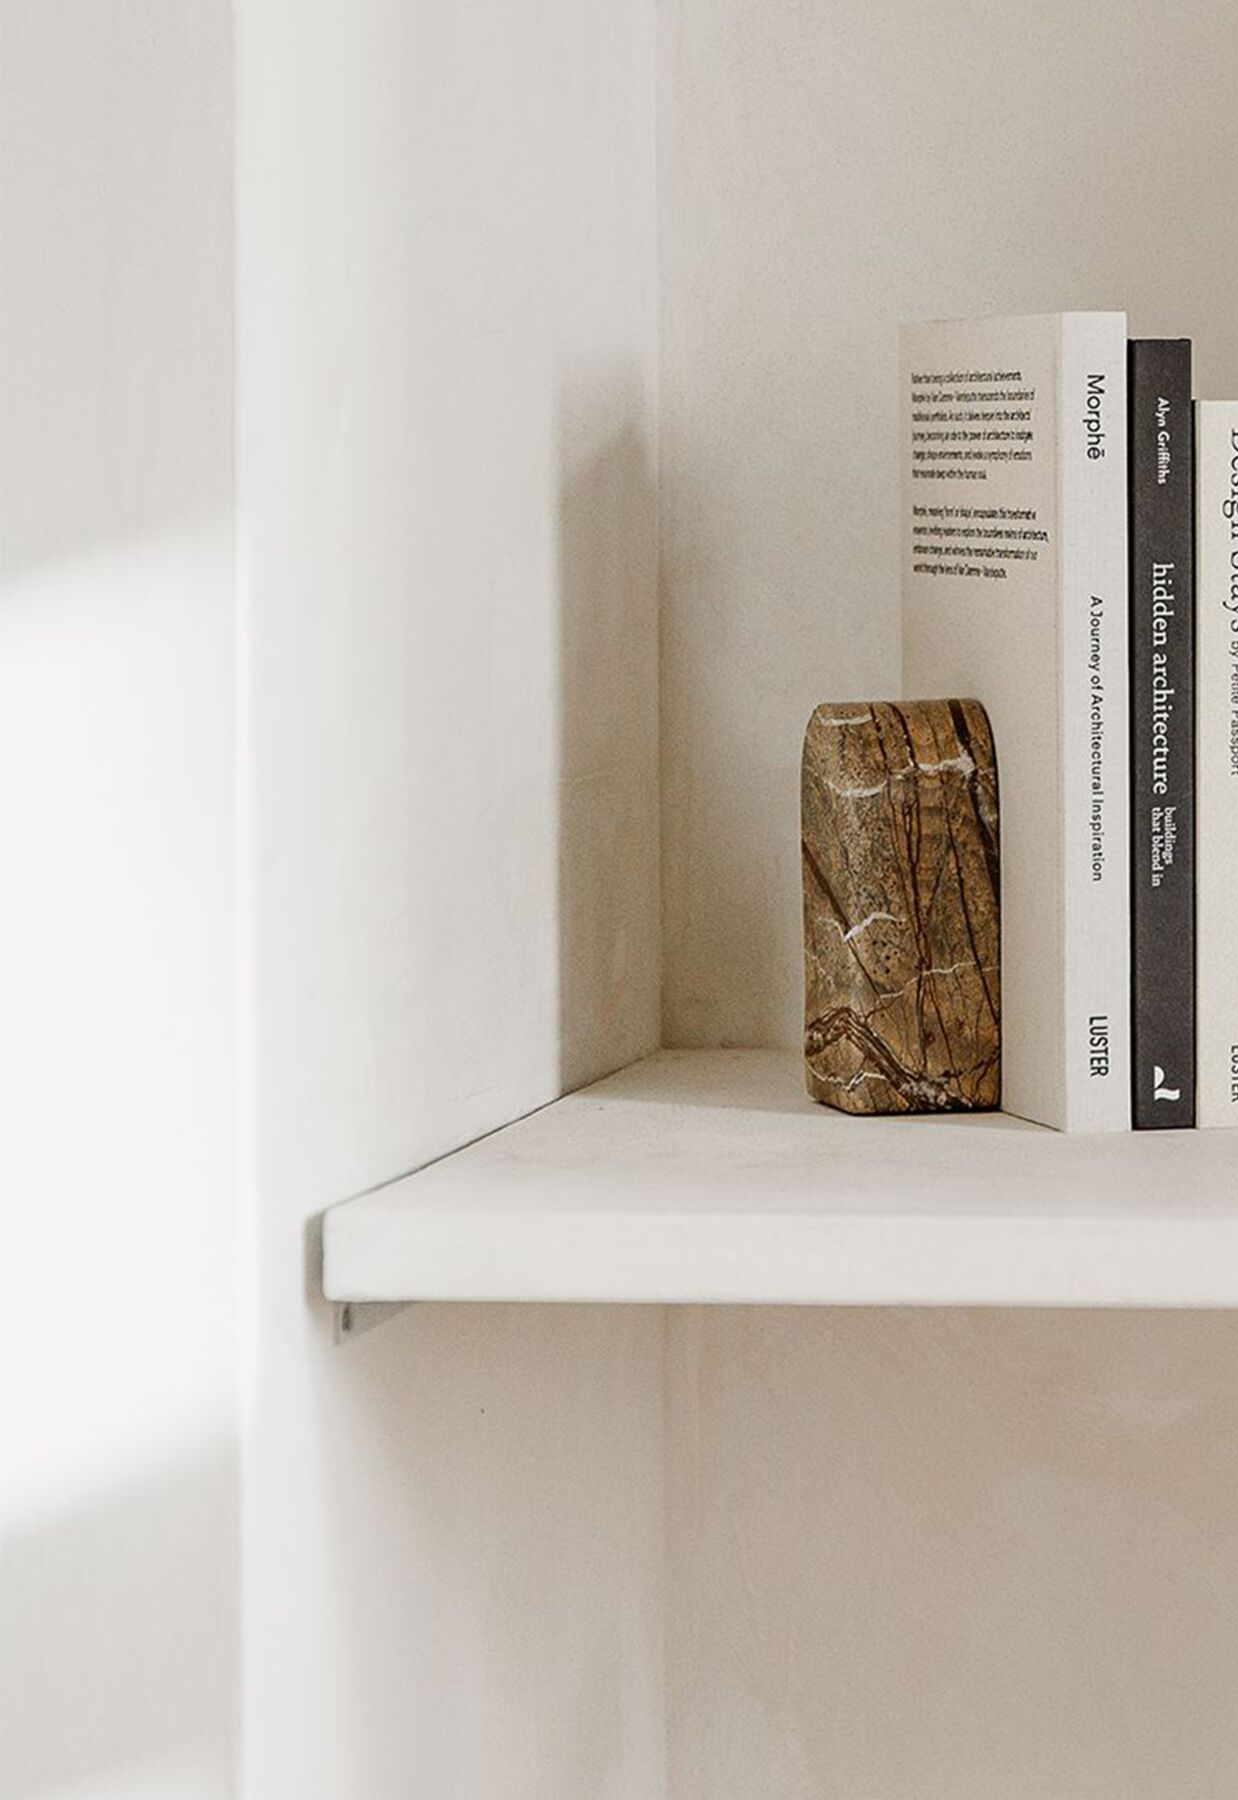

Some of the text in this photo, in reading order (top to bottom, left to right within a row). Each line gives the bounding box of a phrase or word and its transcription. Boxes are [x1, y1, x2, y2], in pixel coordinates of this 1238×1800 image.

[1082, 374, 1106, 460] Morphē
[1155, 397, 1170, 484] Alyn Griffiths
[1152, 562, 1175, 795] hidden architecture
[1088, 595, 1106, 882] A Journey of Architectural Inspiration
[1151, 807, 1163, 887] that blend in
[1164, 807, 1176, 864] buildings
[1089, 1015, 1109, 1077] LUSTER
